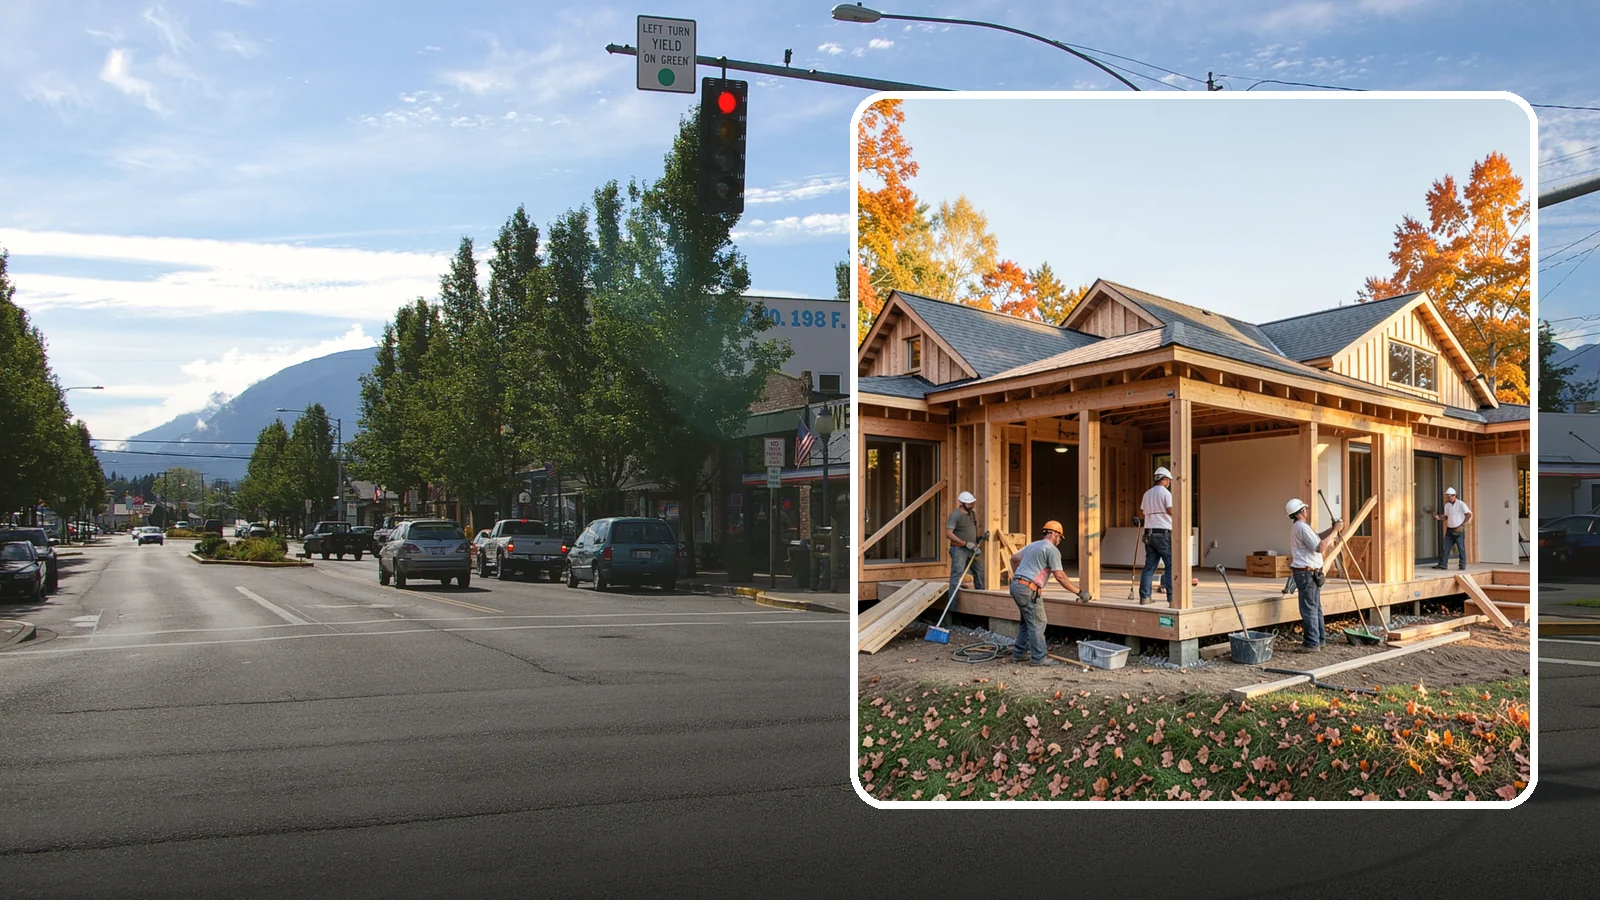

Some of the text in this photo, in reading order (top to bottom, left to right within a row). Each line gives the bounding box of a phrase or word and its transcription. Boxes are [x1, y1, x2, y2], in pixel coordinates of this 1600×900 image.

[643, 23, 690, 37] LEFT TURN
[652, 38, 682, 52] YIELD
[644, 53, 689, 66] ON GREEN
[791, 309, 826, 328] 198
[831, 311, 847, 329] F.
